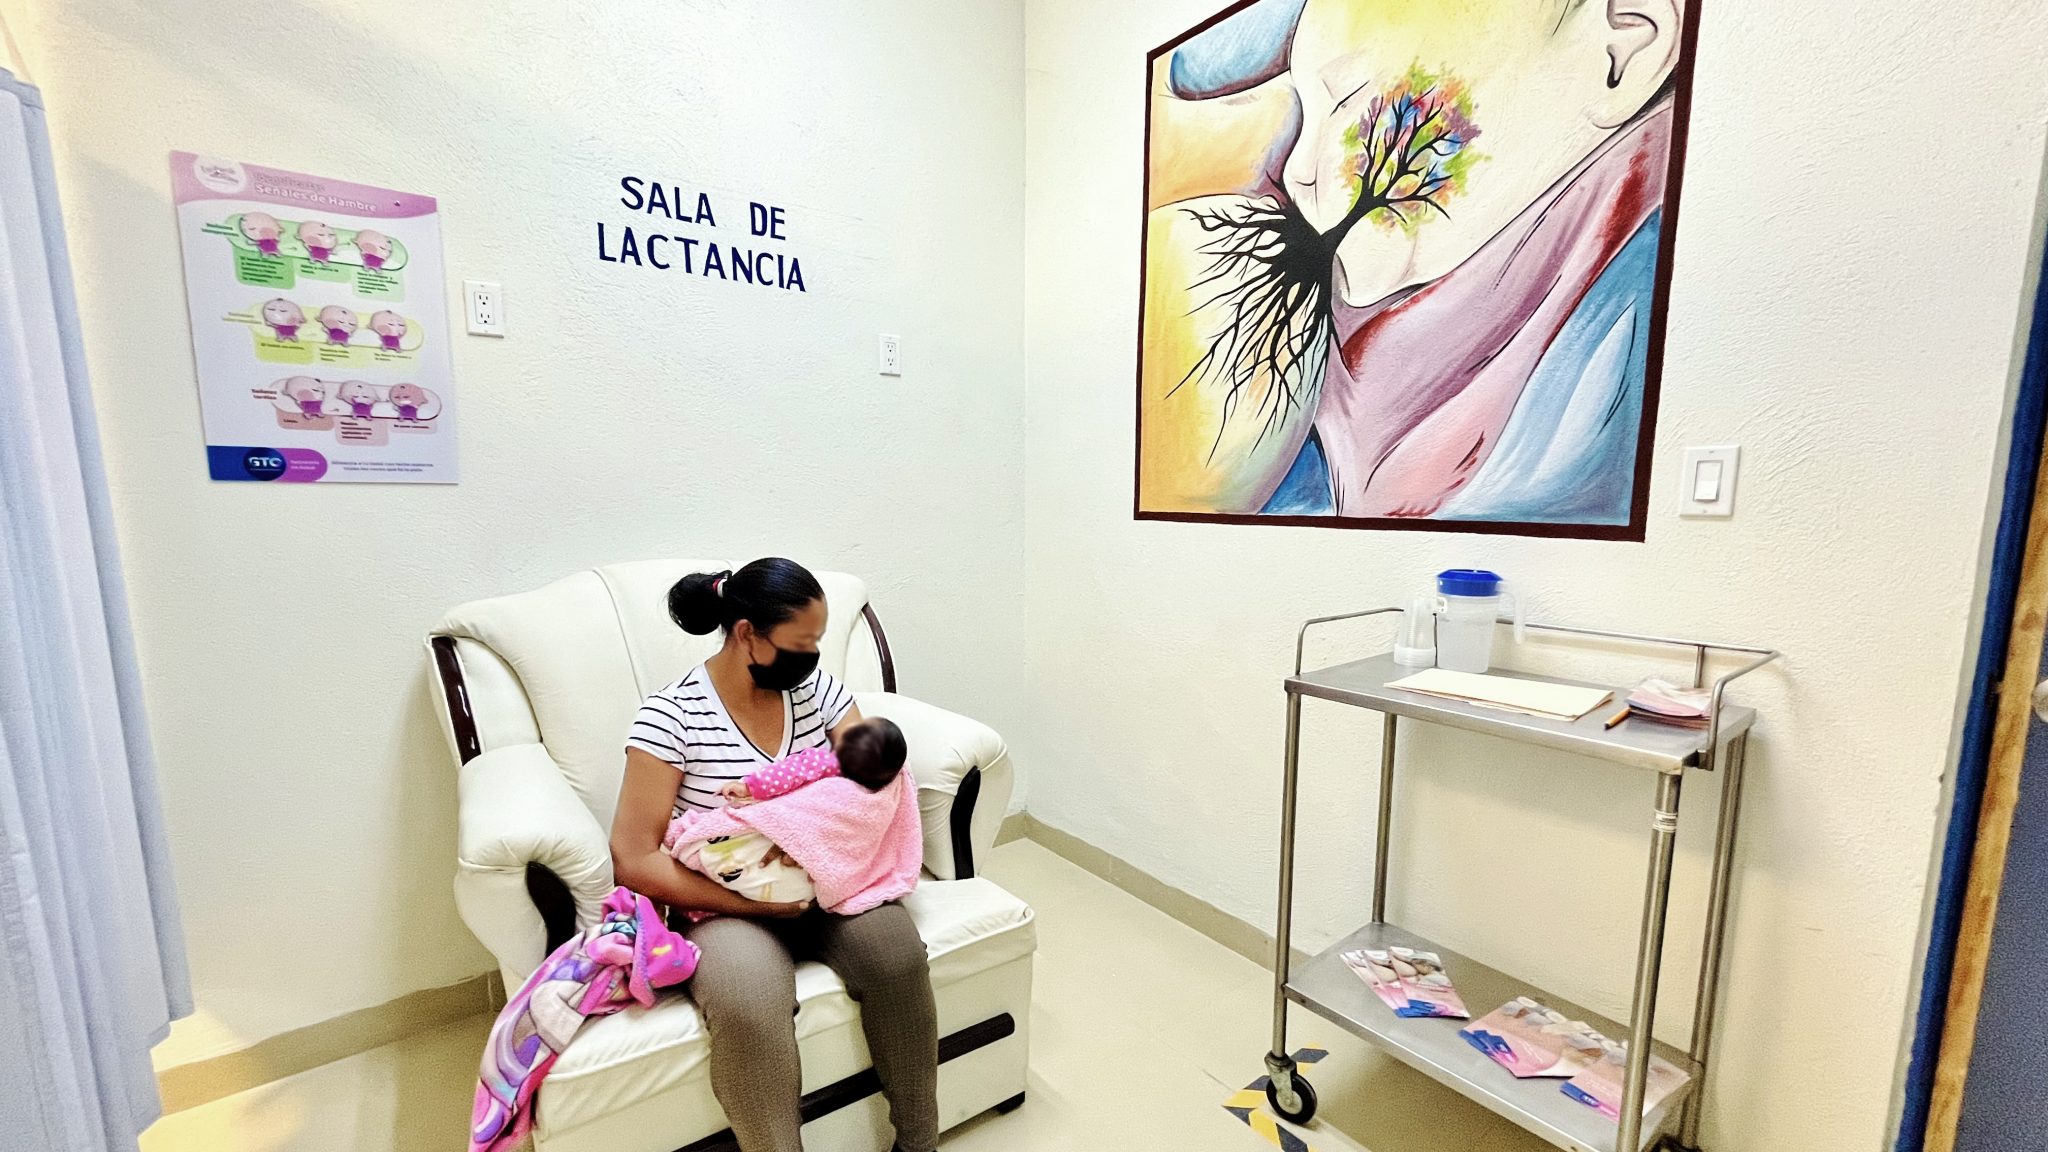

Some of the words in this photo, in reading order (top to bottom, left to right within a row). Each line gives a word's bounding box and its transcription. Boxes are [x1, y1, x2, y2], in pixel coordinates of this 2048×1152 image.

[310, 191, 327, 204] de
[328, 195, 378, 213] Hambre
[620, 176, 716, 228] SALA
[749, 201, 786, 241] DE
[597, 221, 807, 293] LACTANCIA
